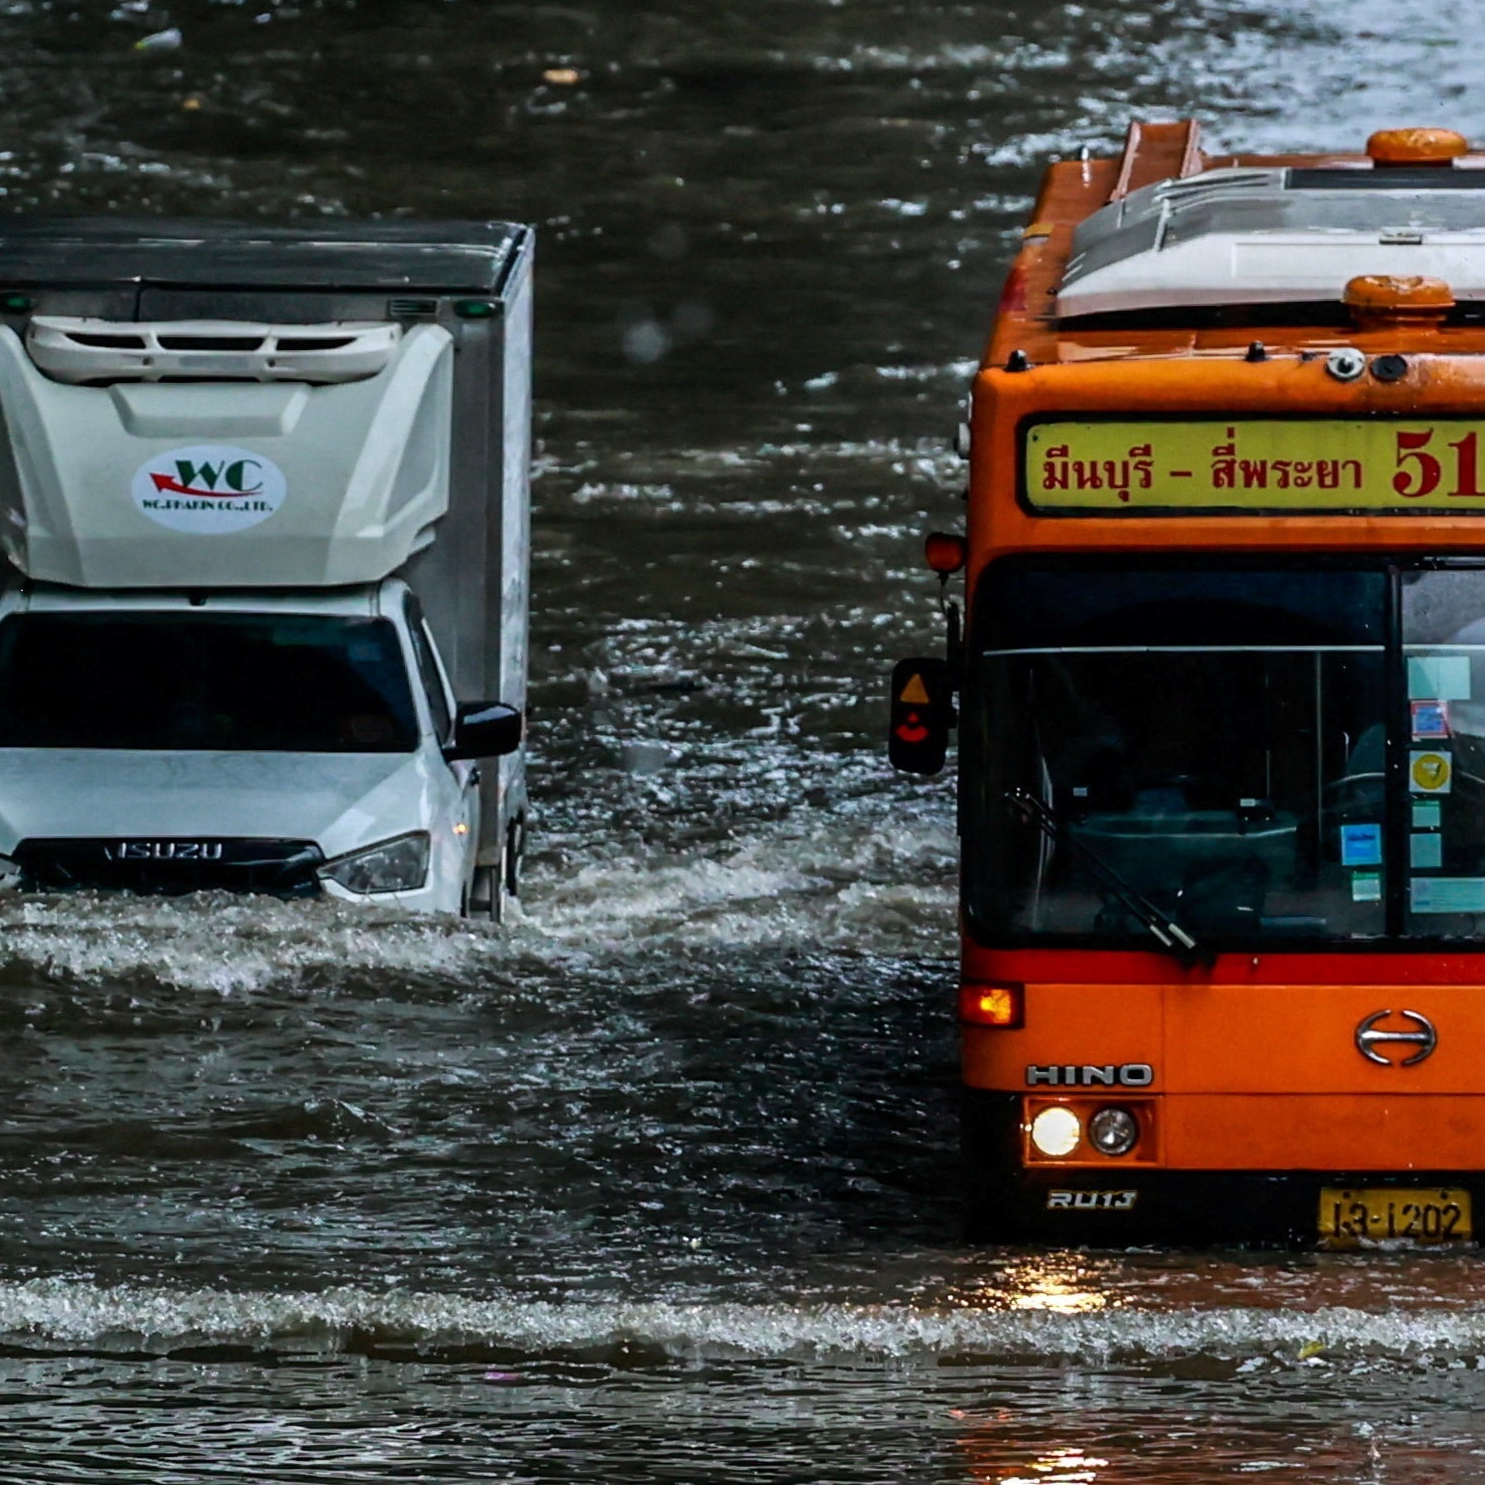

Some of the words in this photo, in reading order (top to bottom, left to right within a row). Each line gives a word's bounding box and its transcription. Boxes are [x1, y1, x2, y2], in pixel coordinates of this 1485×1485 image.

[174, 459, 264, 492] WC
[1042, 444, 1155, 503] มีนบุรี
[1211, 426, 1363, 489] สี่พระยา
[117, 841, 223, 859] ISUZU
[1026, 1063, 1154, 1086] HINO
